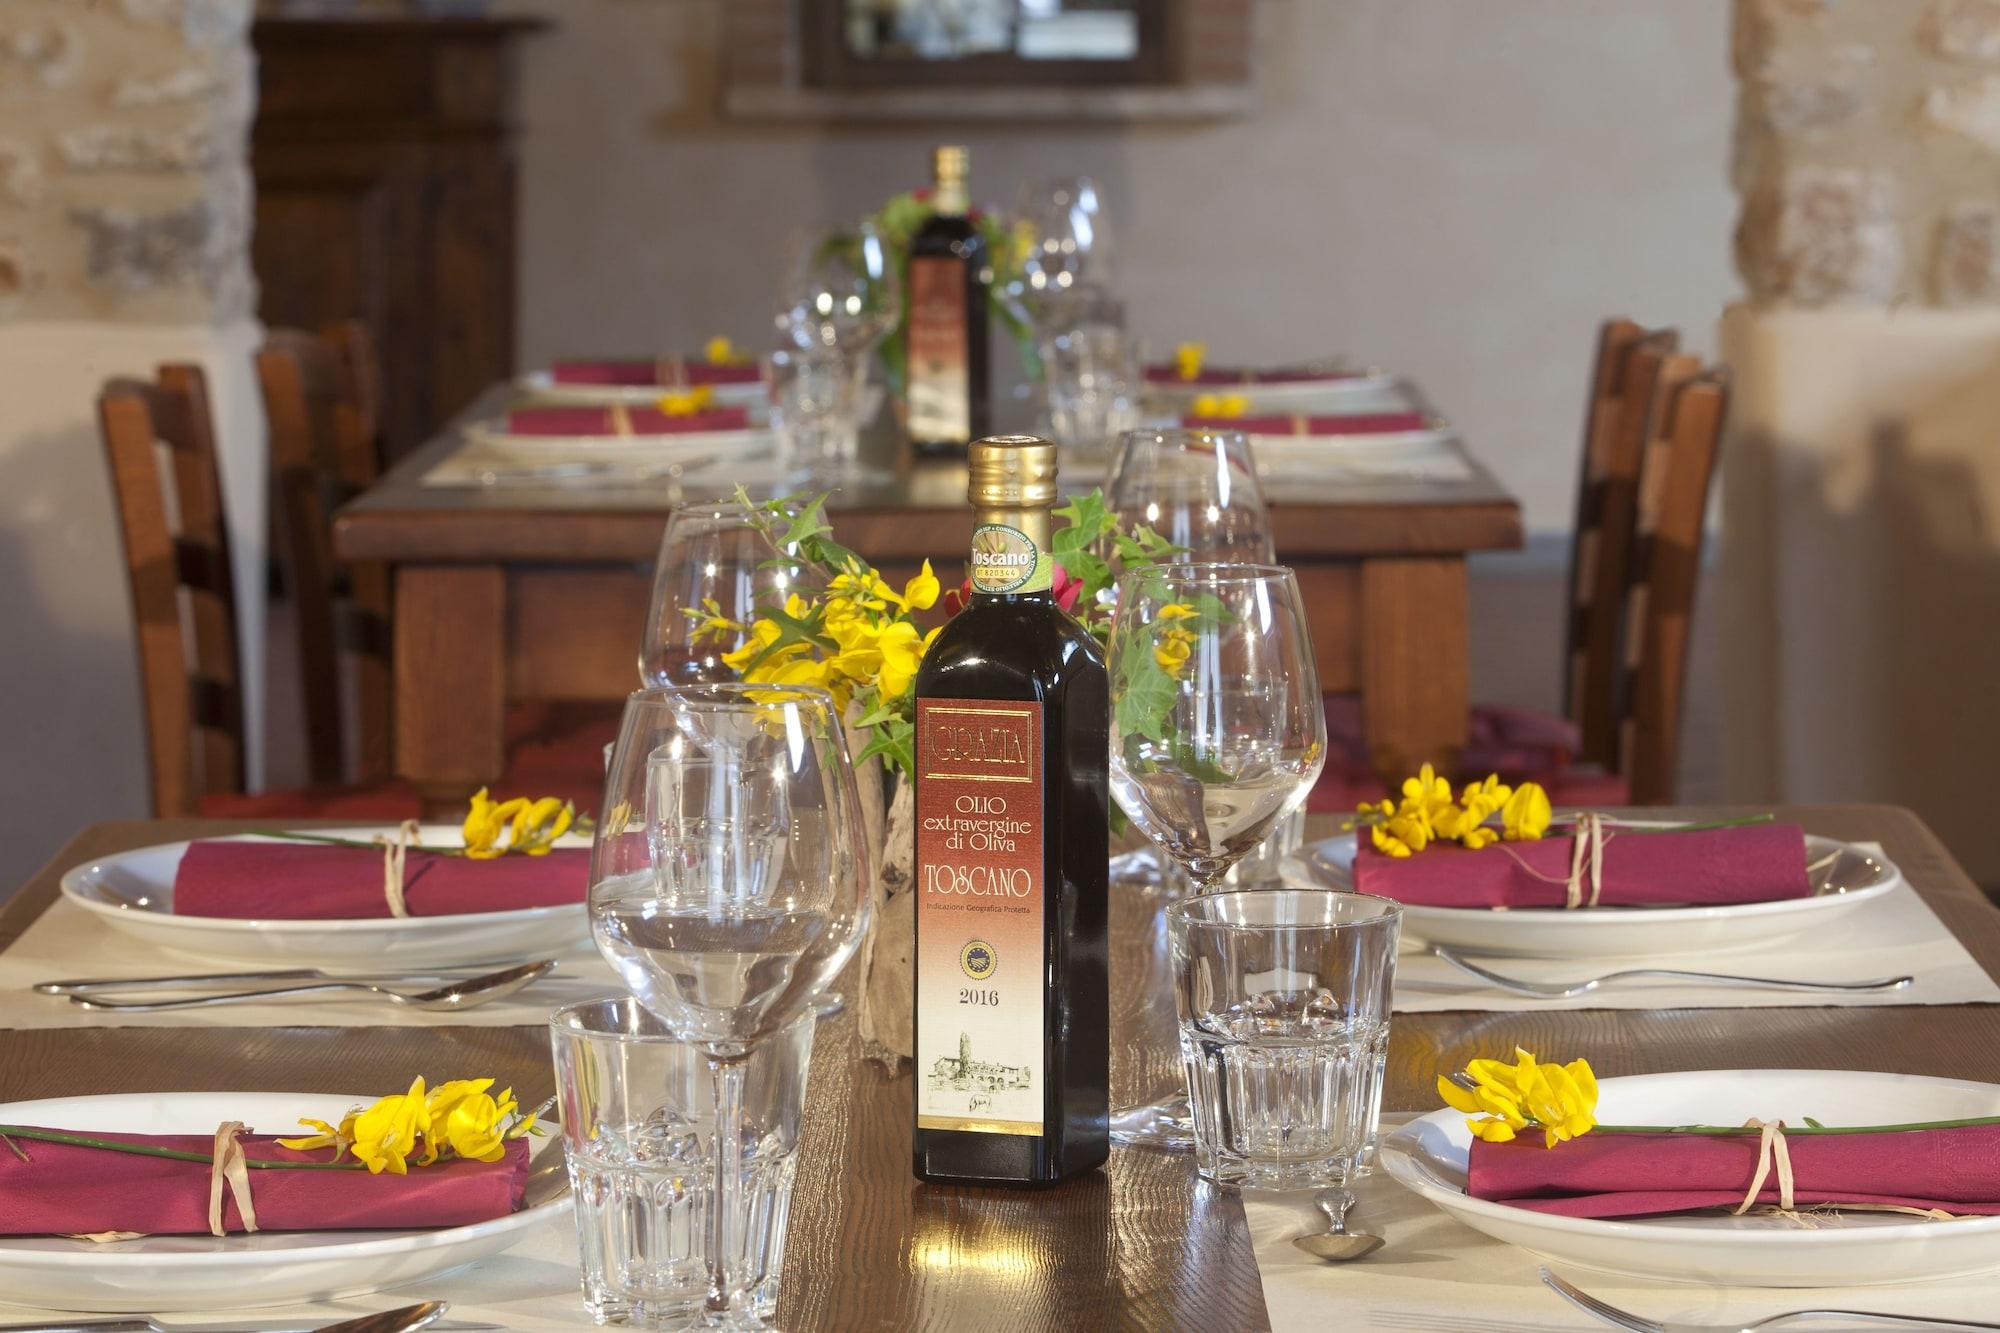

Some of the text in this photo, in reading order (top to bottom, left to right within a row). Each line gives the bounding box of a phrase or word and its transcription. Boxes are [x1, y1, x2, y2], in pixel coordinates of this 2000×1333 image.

[972, 548, 1029, 566] Toscano
[932, 726, 1026, 763] GRAZIA
[955, 795, 1007, 815] OLIO
[923, 815, 1032, 840] extravergine
[946, 831, 1016, 852] di Oliva
[924, 864, 1032, 898] TOSCANO
[926, 902, 1031, 914] Indicazione Geografica Protetta
[959, 987, 999, 1007] 2016
